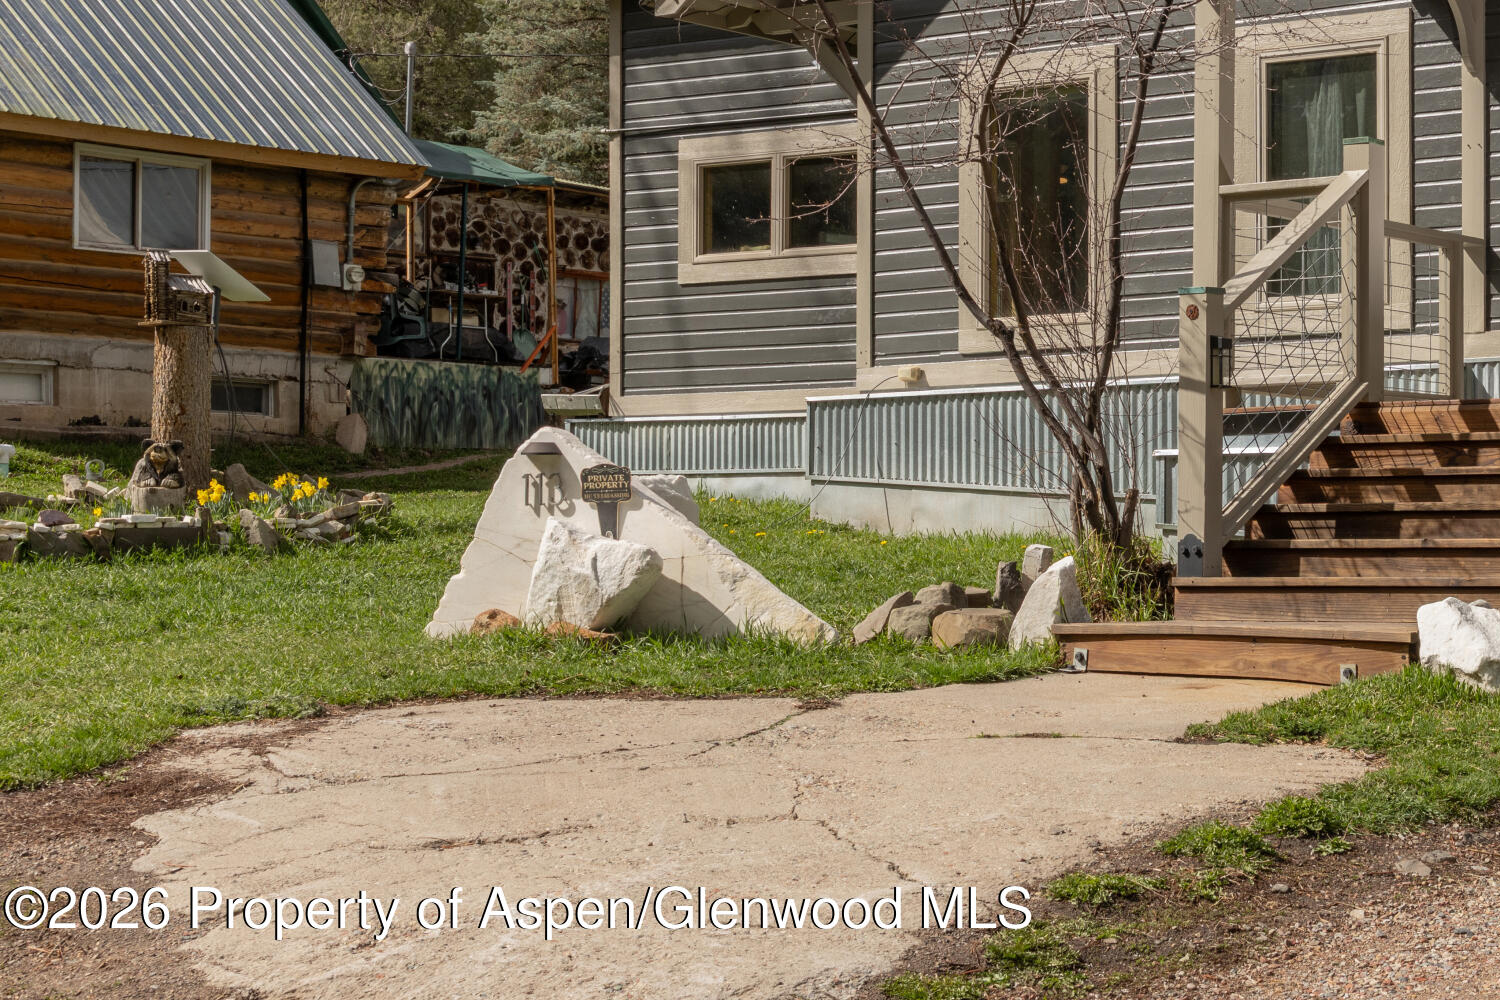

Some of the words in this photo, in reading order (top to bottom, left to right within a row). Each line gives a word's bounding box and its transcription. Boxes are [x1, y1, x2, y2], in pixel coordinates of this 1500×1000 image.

[587, 474, 625, 482] PRIVATE
[522, 472, 565, 506] 113
[583, 481, 629, 489] PROPERTY
